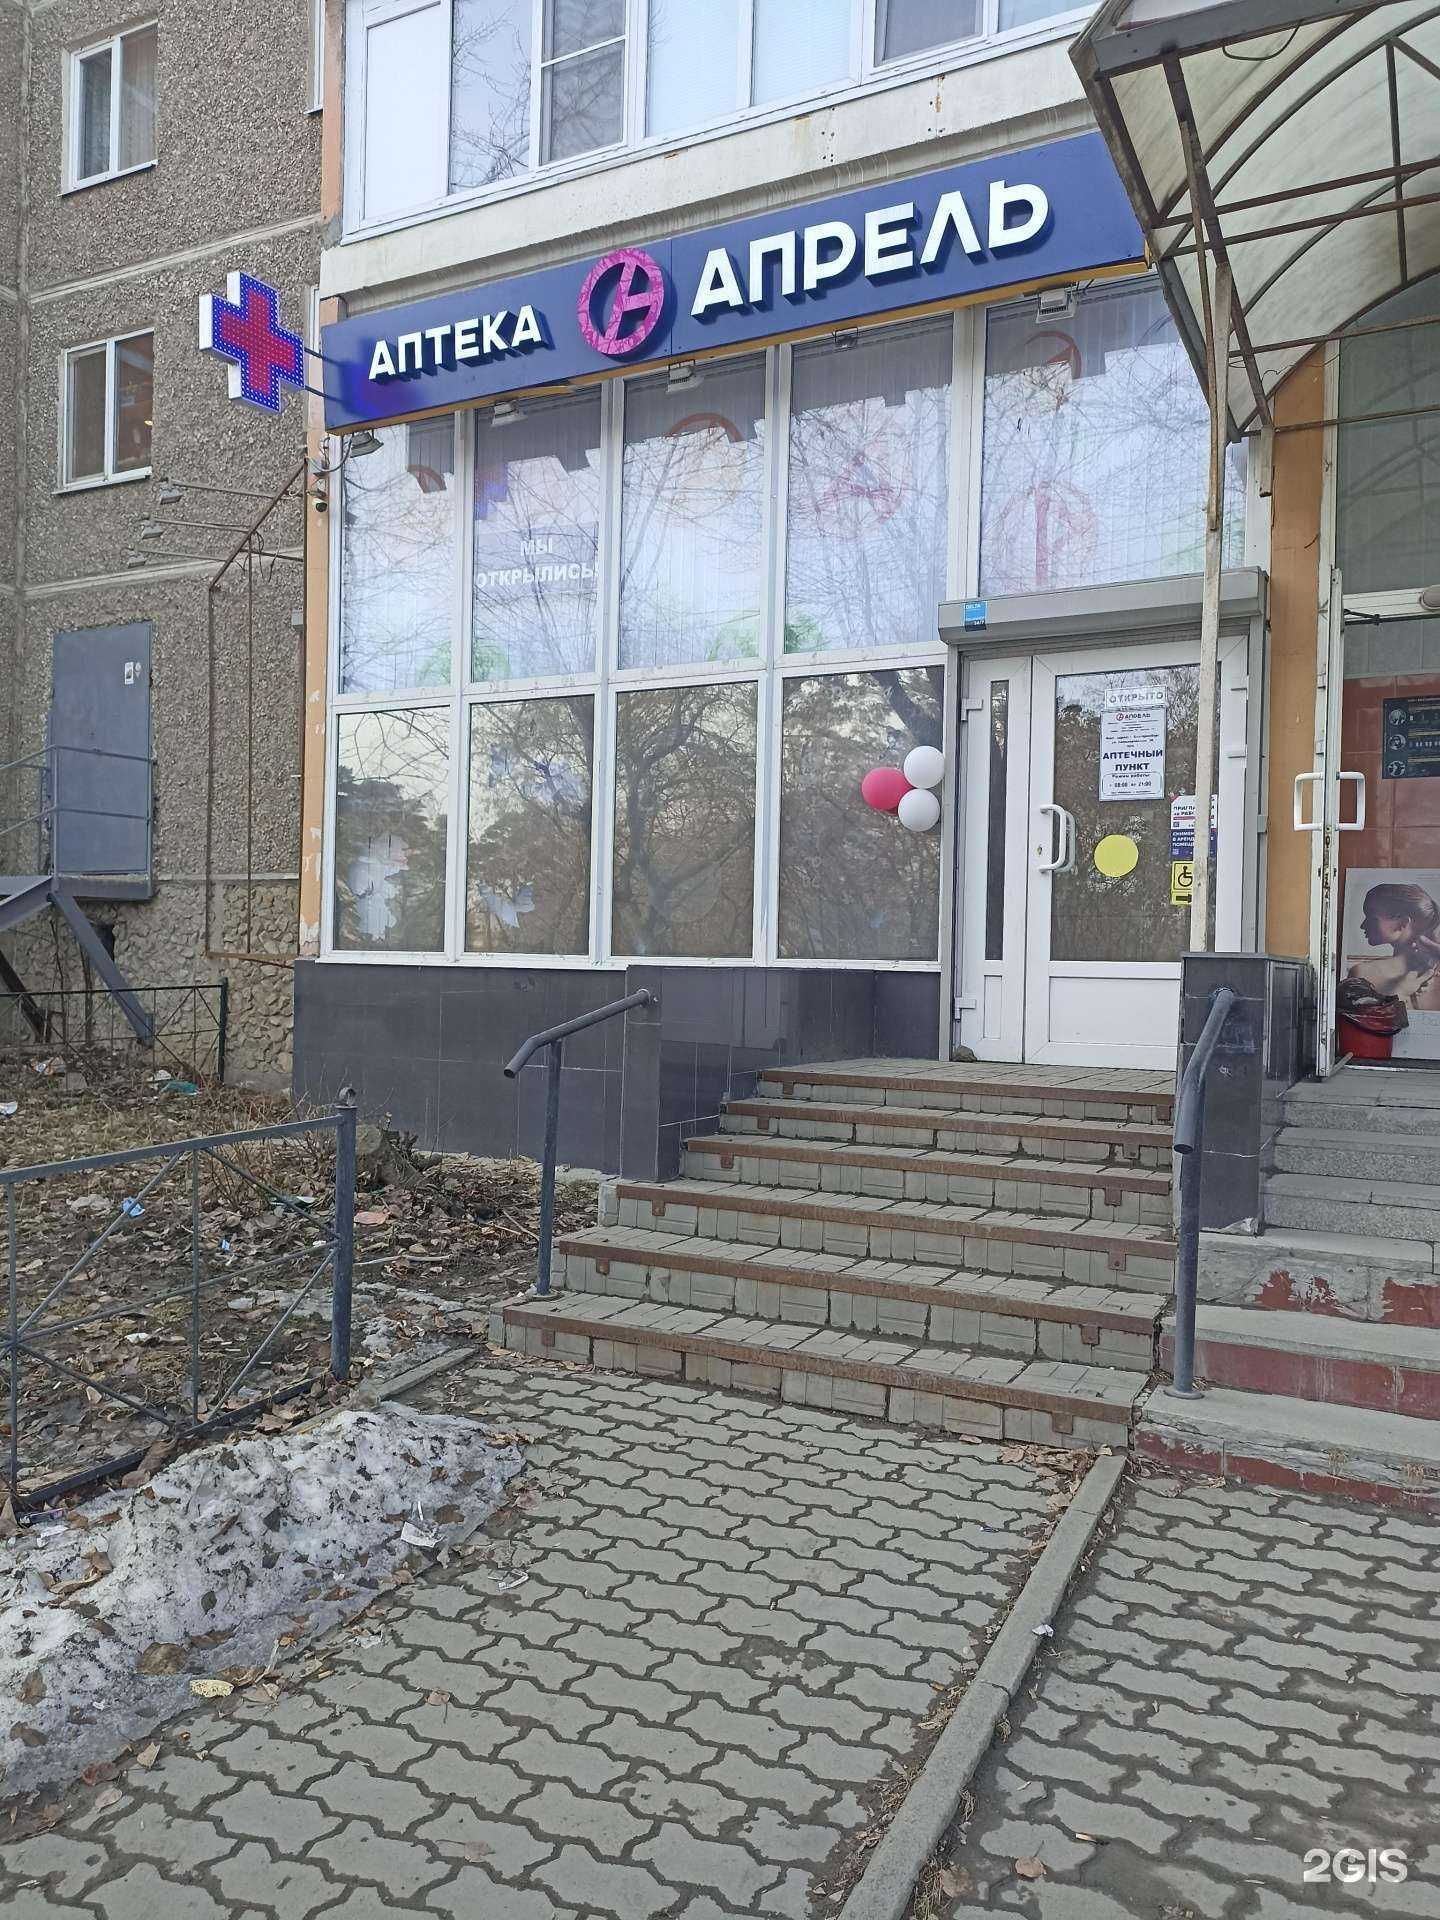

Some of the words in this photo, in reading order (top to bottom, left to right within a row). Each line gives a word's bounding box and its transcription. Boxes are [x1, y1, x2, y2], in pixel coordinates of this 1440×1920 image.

[368, 304, 543, 380] АПТЕКА
[690, 180, 1050, 316] АПРЕЛЬ
[520, 538, 553, 556] МЫ
[1109, 691, 1164, 704] ОТКРЫТО
[1102, 748, 1163, 760] АПТЕЧНЫЙ
[1115, 762, 1151, 772] ПУНКТ
